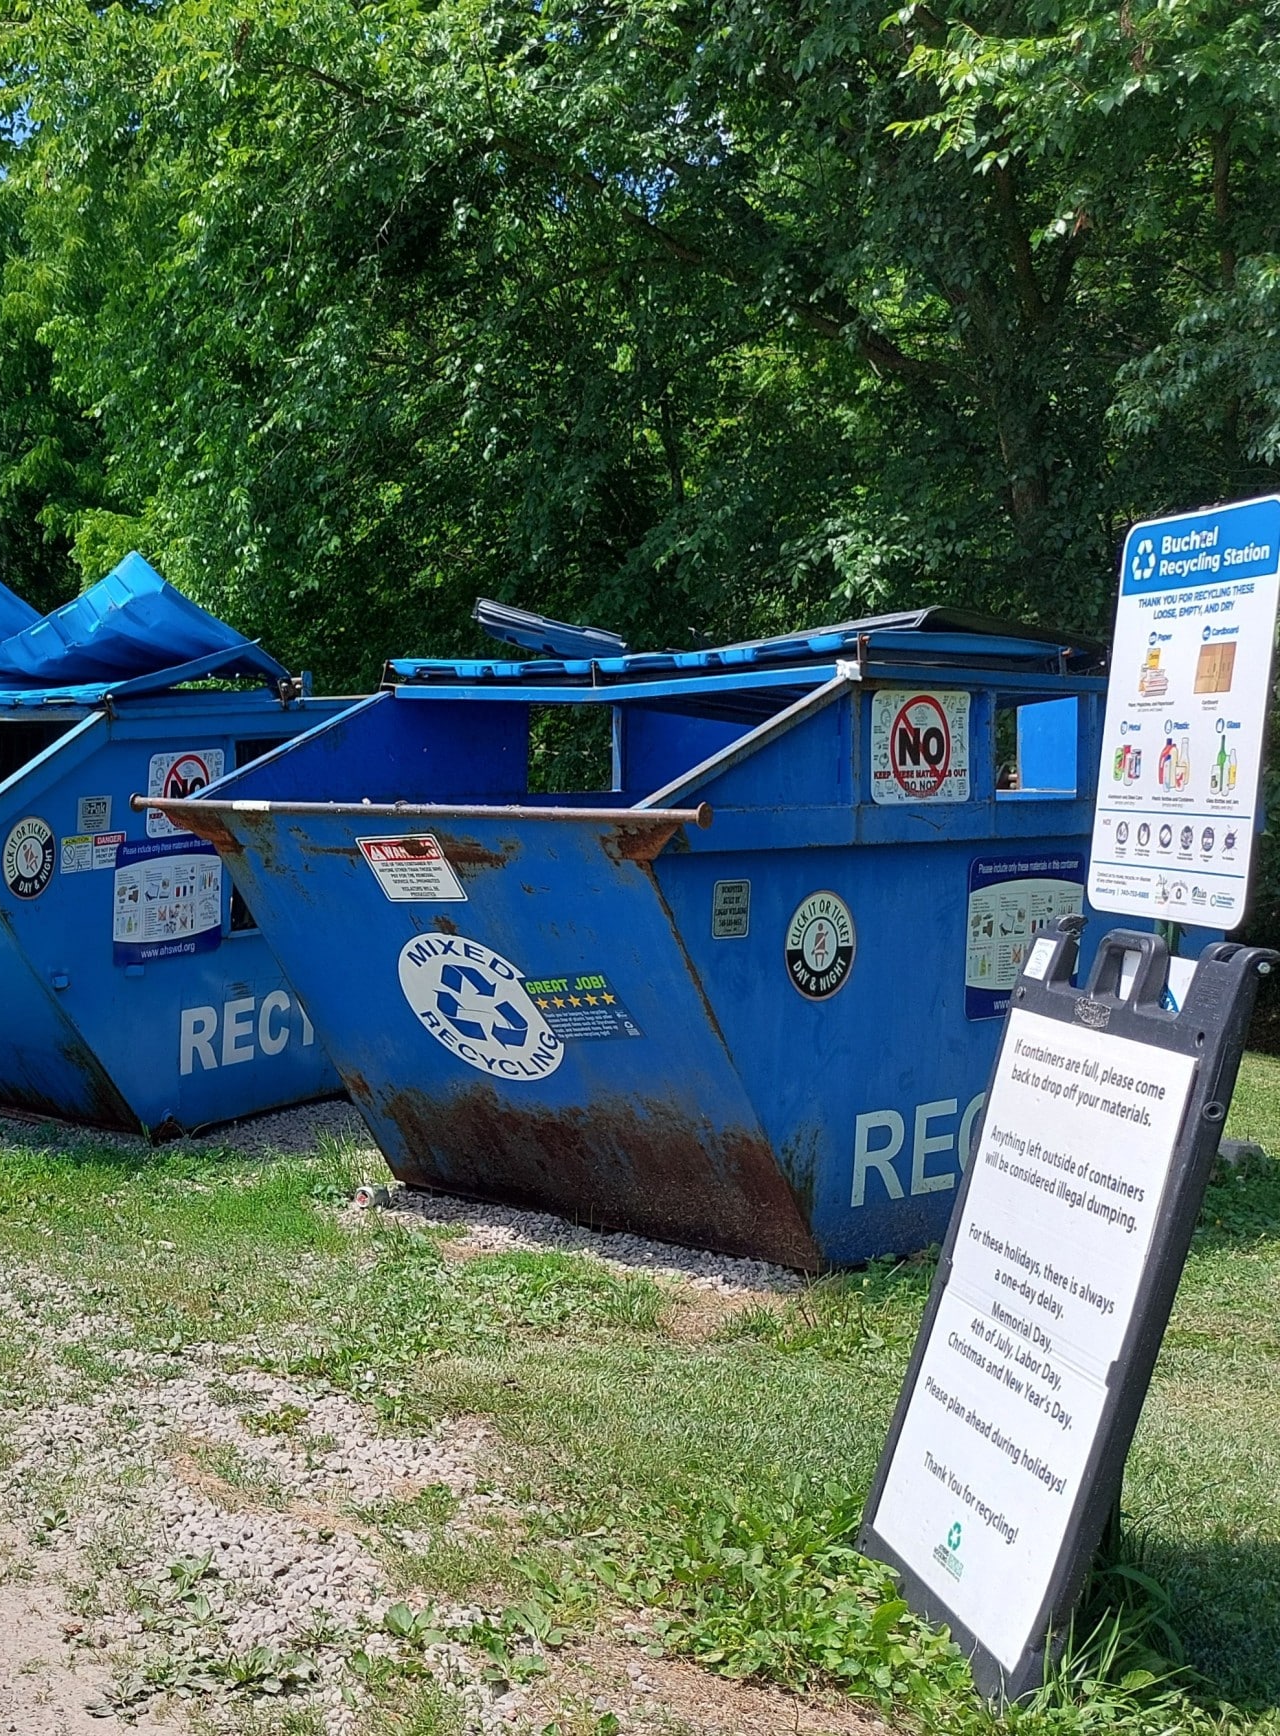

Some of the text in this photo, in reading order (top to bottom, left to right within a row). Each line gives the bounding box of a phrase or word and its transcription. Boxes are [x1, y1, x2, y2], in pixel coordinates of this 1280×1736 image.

[1159, 542, 1270, 578] Recycling Station
[1162, 526, 1219, 555] Buchtel
[1138, 583, 1255, 608] THANK YOU FOR RECYCLING THESE
[1153, 600, 1236, 620] LOOSE, EMPTY, AND DRY
[898, 727, 945, 766] NO
[6, 823, 49, 879] CLICK IT OR TICKET
[96, 835, 122, 845] DANGER
[18, 880, 32, 894] DAY
[40, 848, 53, 882] NIGHT
[791, 899, 850, 946] CLICK IT OR TICKET
[141, 942, 196, 958] www.ahswd.org
[407, 938, 515, 982] MIXED
[792, 956, 846, 992] DAY & NIGHT
[525, 975, 608, 994] GREAT JOB!
[420, 1010, 559, 1077] RECYCLING
[1014, 1038, 1166, 1100] If containers are full, please come
[1011, 1064, 1152, 1128] back to drop off your materials.
[990, 1125, 1145, 1202] Anything left outside of containers
[985, 1151, 1138, 1234] will be considered illegal dumping.
[969, 1222, 1115, 1315] For these holidays, there is always
[994, 1268, 1064, 1320] a one-day delay.
[991, 1301, 1053, 1354] Memorial Day,
[948, 1331, 1072, 1430] Christmas and New Year's Day.
[970, 1318, 1062, 1392] 4th of July, Labor Day,
[924, 1376, 1068, 1495] Please plan ahead during holidays!
[923, 1450, 1020, 1545] Thank You for recycling!
